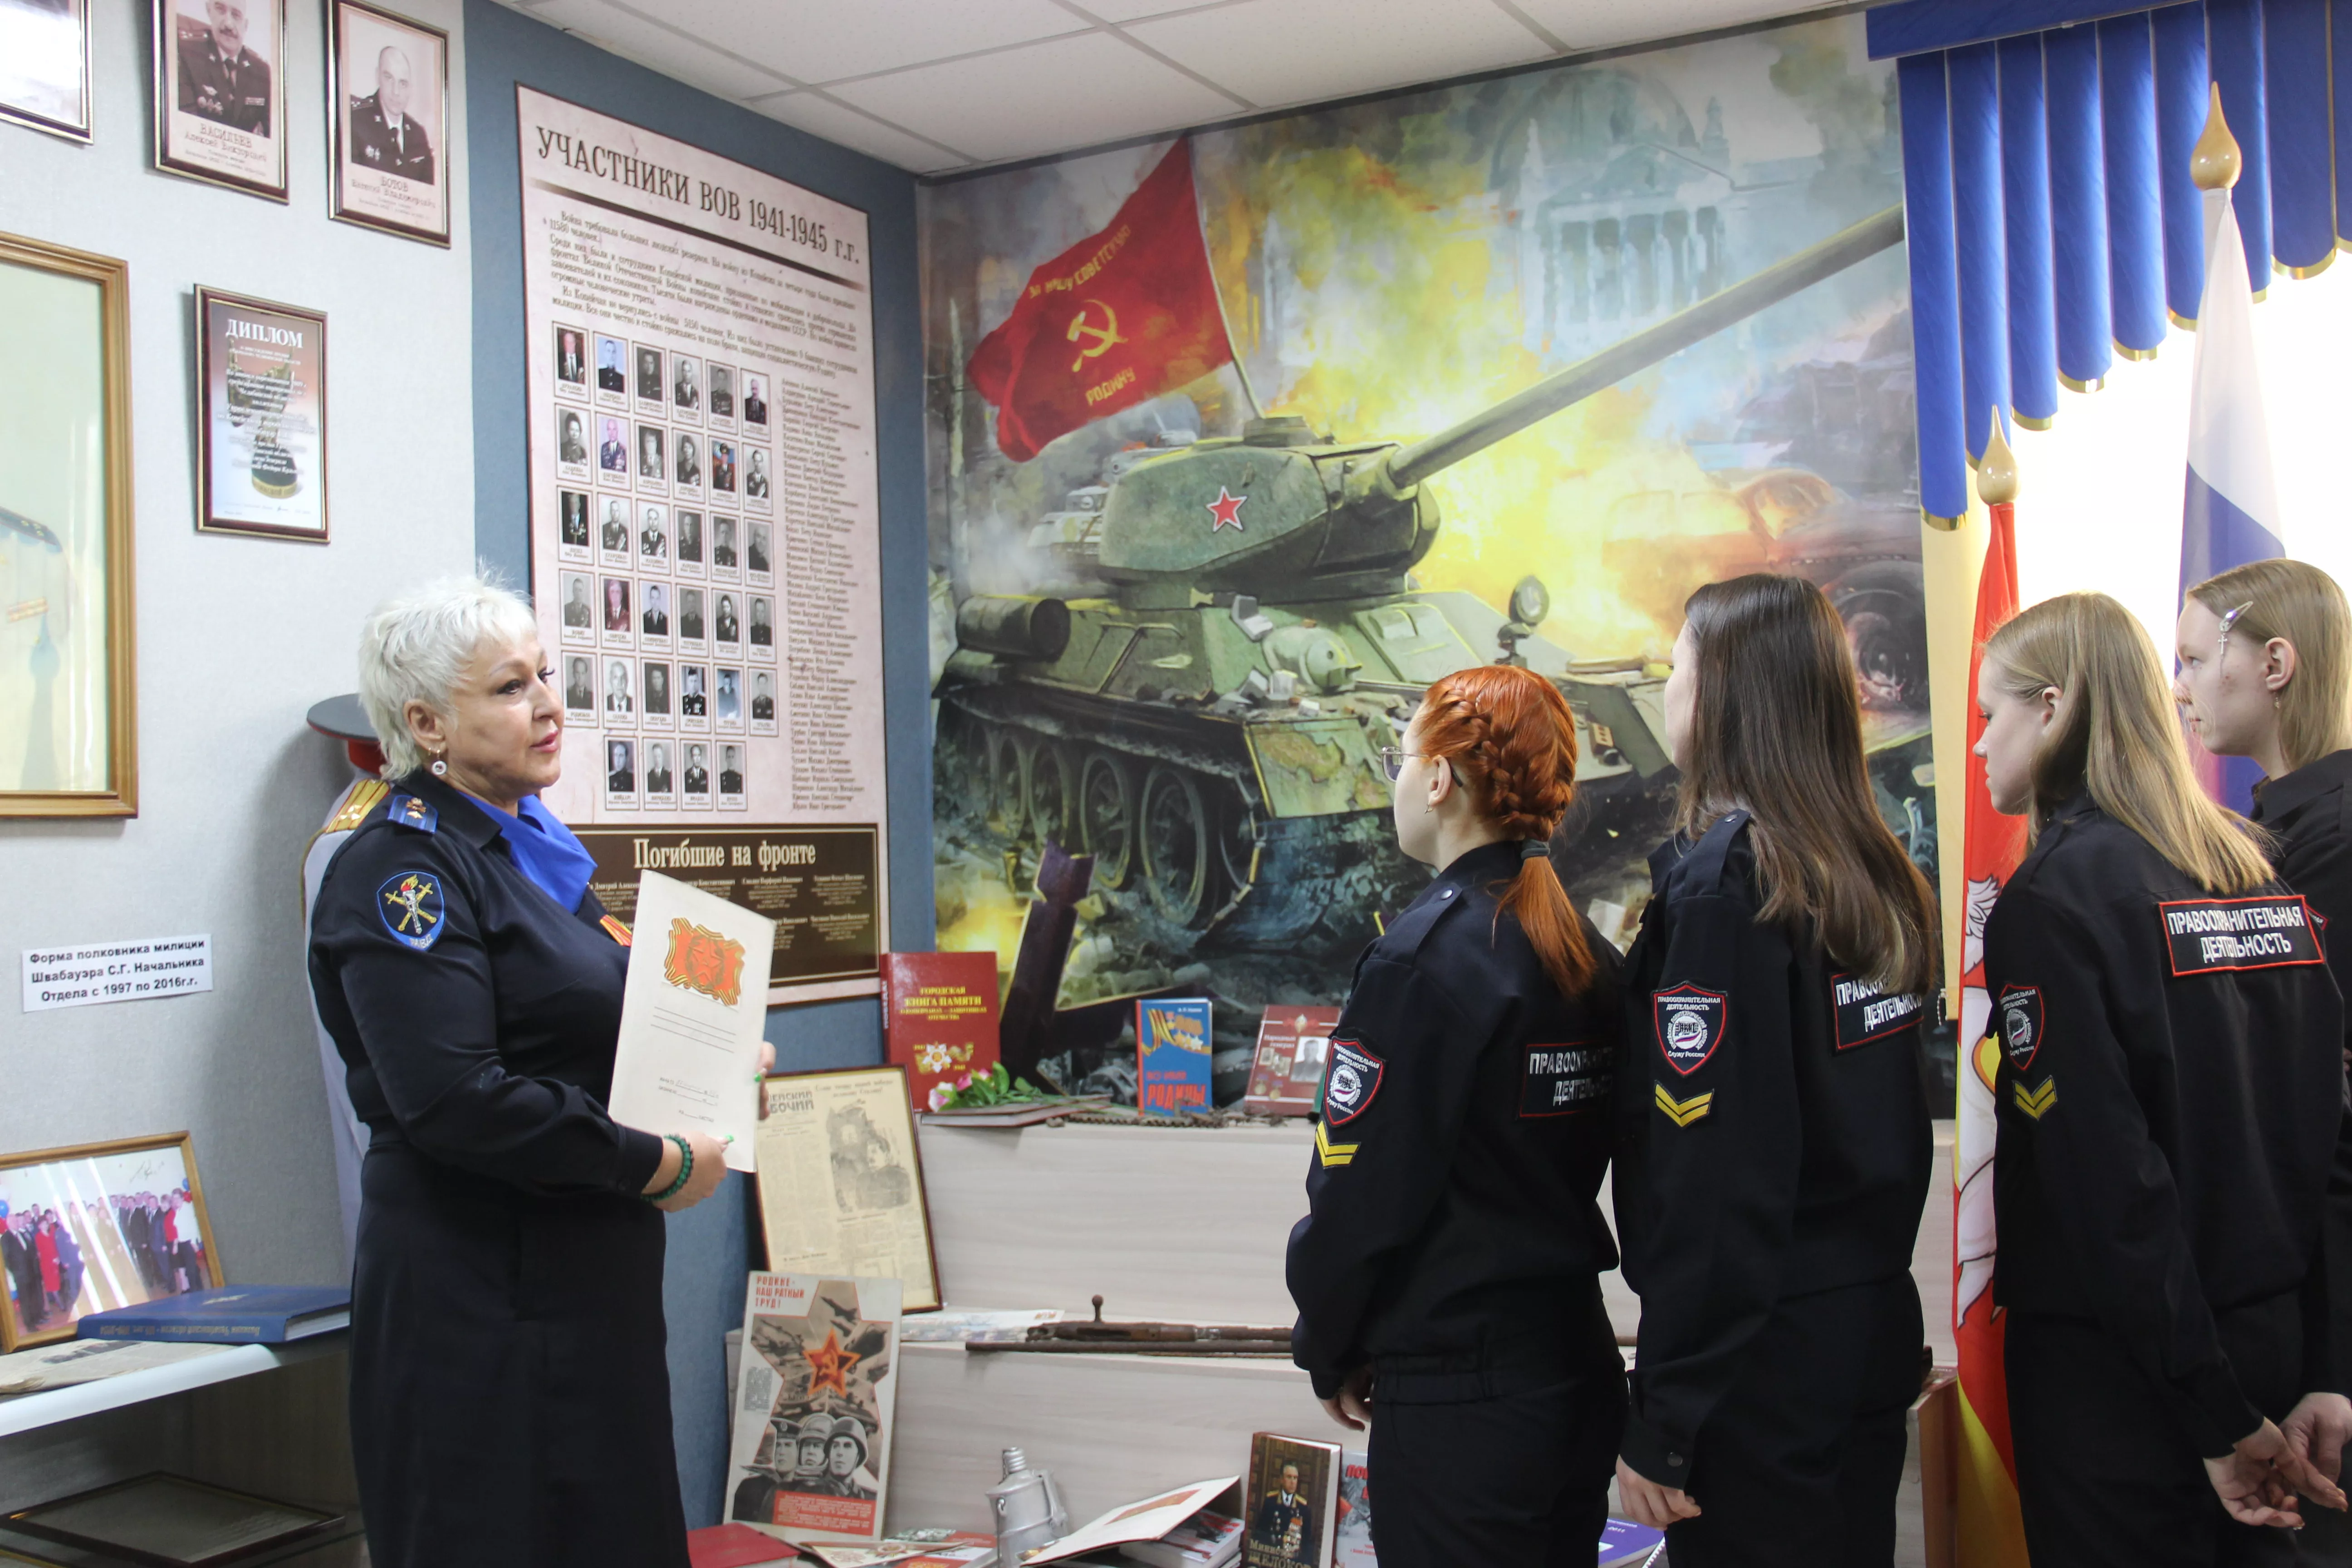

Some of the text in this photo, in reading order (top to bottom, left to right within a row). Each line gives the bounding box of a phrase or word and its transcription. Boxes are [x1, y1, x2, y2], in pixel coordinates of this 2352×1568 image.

[200, 122, 252, 148] ВАСИЛЬЕВ
[536, 124, 859, 264] УЧАСТНИКИ ВОВ 1941-1945 г.г.
[1045, 277, 1073, 293] НАШУ
[225, 318, 303, 348] ДИПЛОМ
[1086, 367, 1136, 406] РОДИНУ
[633, 836, 816, 871] Погибшие на фронте
[2167, 906, 2304, 935] ПРАВООХРАНИТЕЛЬНАЯ
[30, 940, 205, 965] Форма полковника милиции
[2200, 932, 2291, 964] ДЕЯТЕЛЬНОСТЬ
[32, 958, 204, 983] Швабауэра С.Г. Начальника
[41, 990, 87, 1002] Отдела
[104, 983, 131, 995] 1997
[136, 982, 150, 991] по
[154, 977, 198, 989] 2016г.г.
[905, 995, 982, 1006] КНИГА ПАМЯТИ
[920, 986, 966, 995] ГОРОДСКАЯ
[1147, 1071, 1186, 1081] ВО ИМЯ
[770, 1100, 814, 1114] БОЧИЙ
[1147, 1083, 1206, 1110] РОДИНЫ
[756, 1287, 804, 1298] НАШ РАТНЫЙ
[757, 1275, 790, 1286] РОДИНЕ
[755, 1298, 781, 1308] ТРУД!
